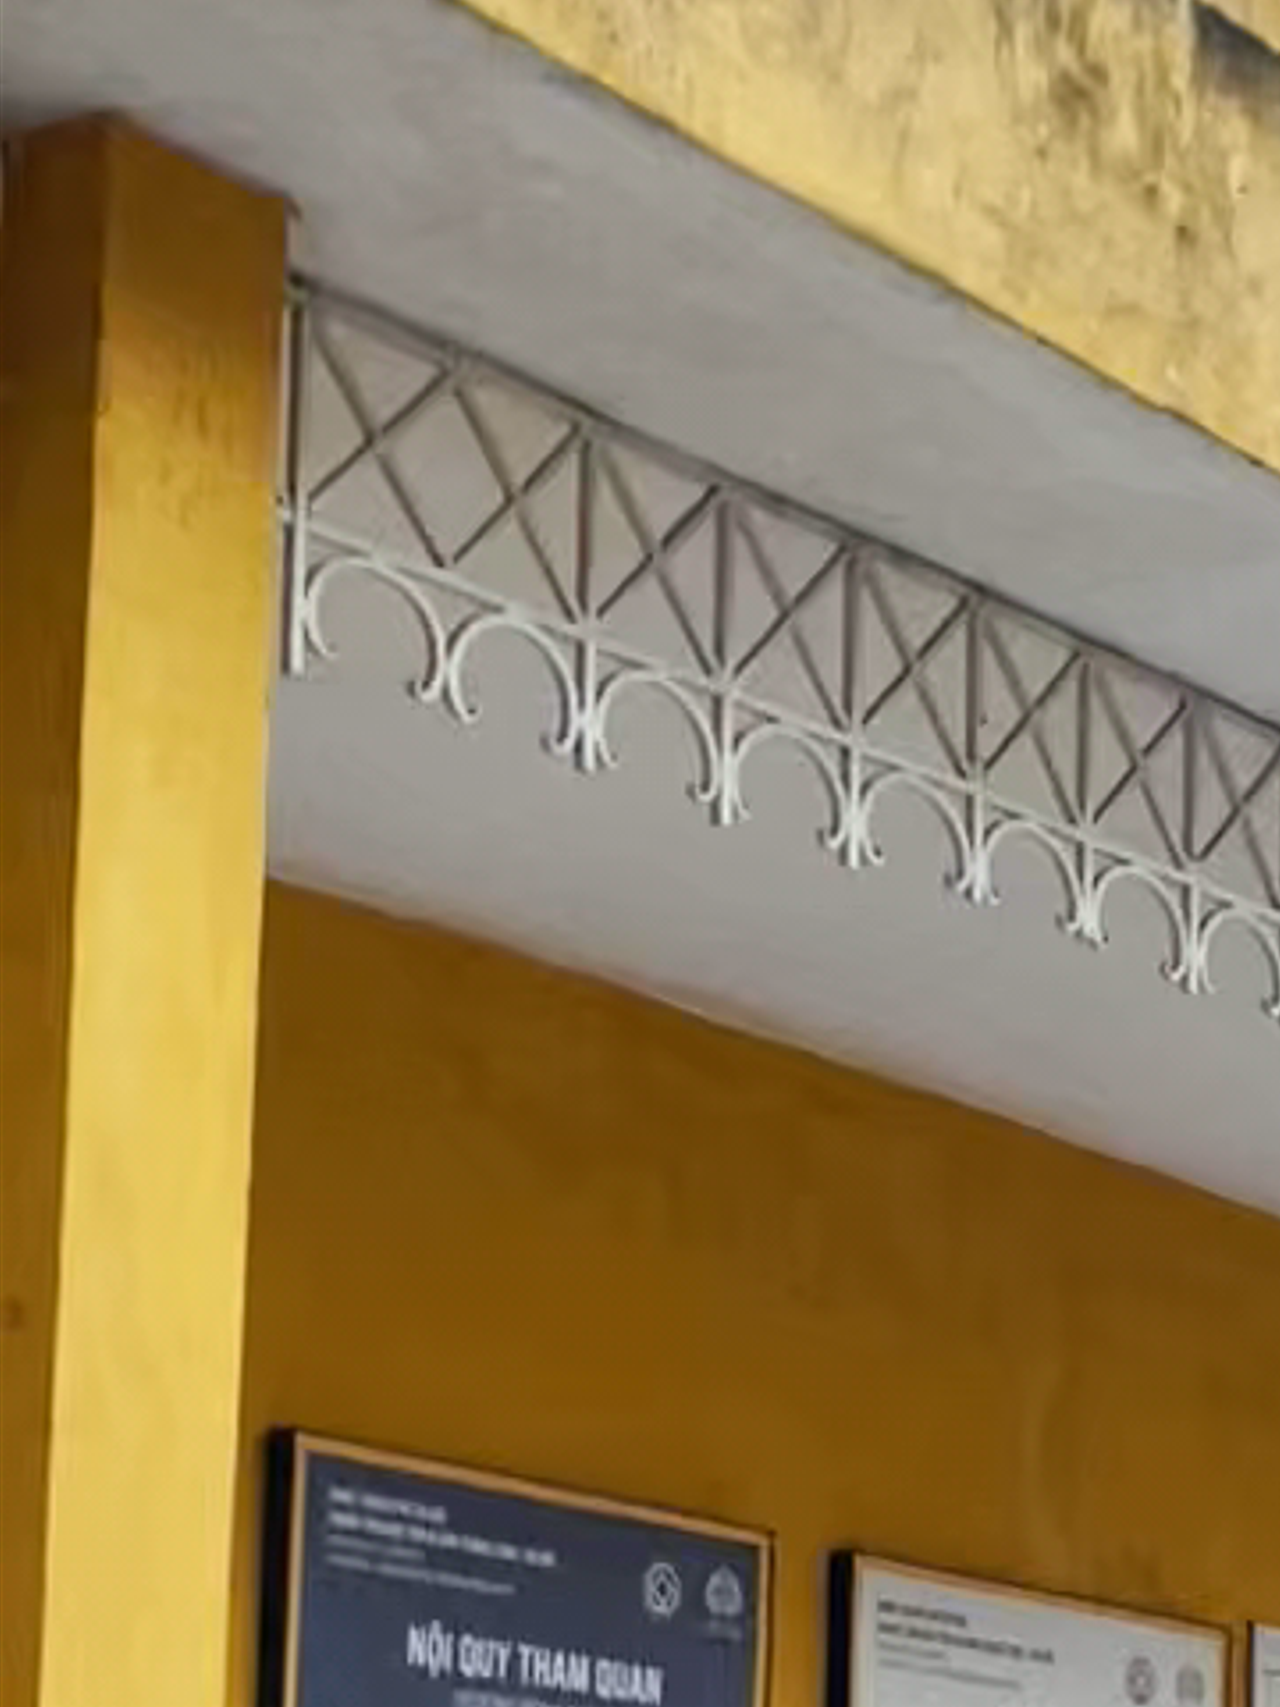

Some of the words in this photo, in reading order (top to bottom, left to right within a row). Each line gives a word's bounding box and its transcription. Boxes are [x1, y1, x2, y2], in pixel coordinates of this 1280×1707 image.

[407, 1619, 454, 1679] NỘI
[458, 1633, 511, 1679] QUY
[518, 1642, 590, 1693] THAM
[595, 1657, 664, 1706] QUAN
